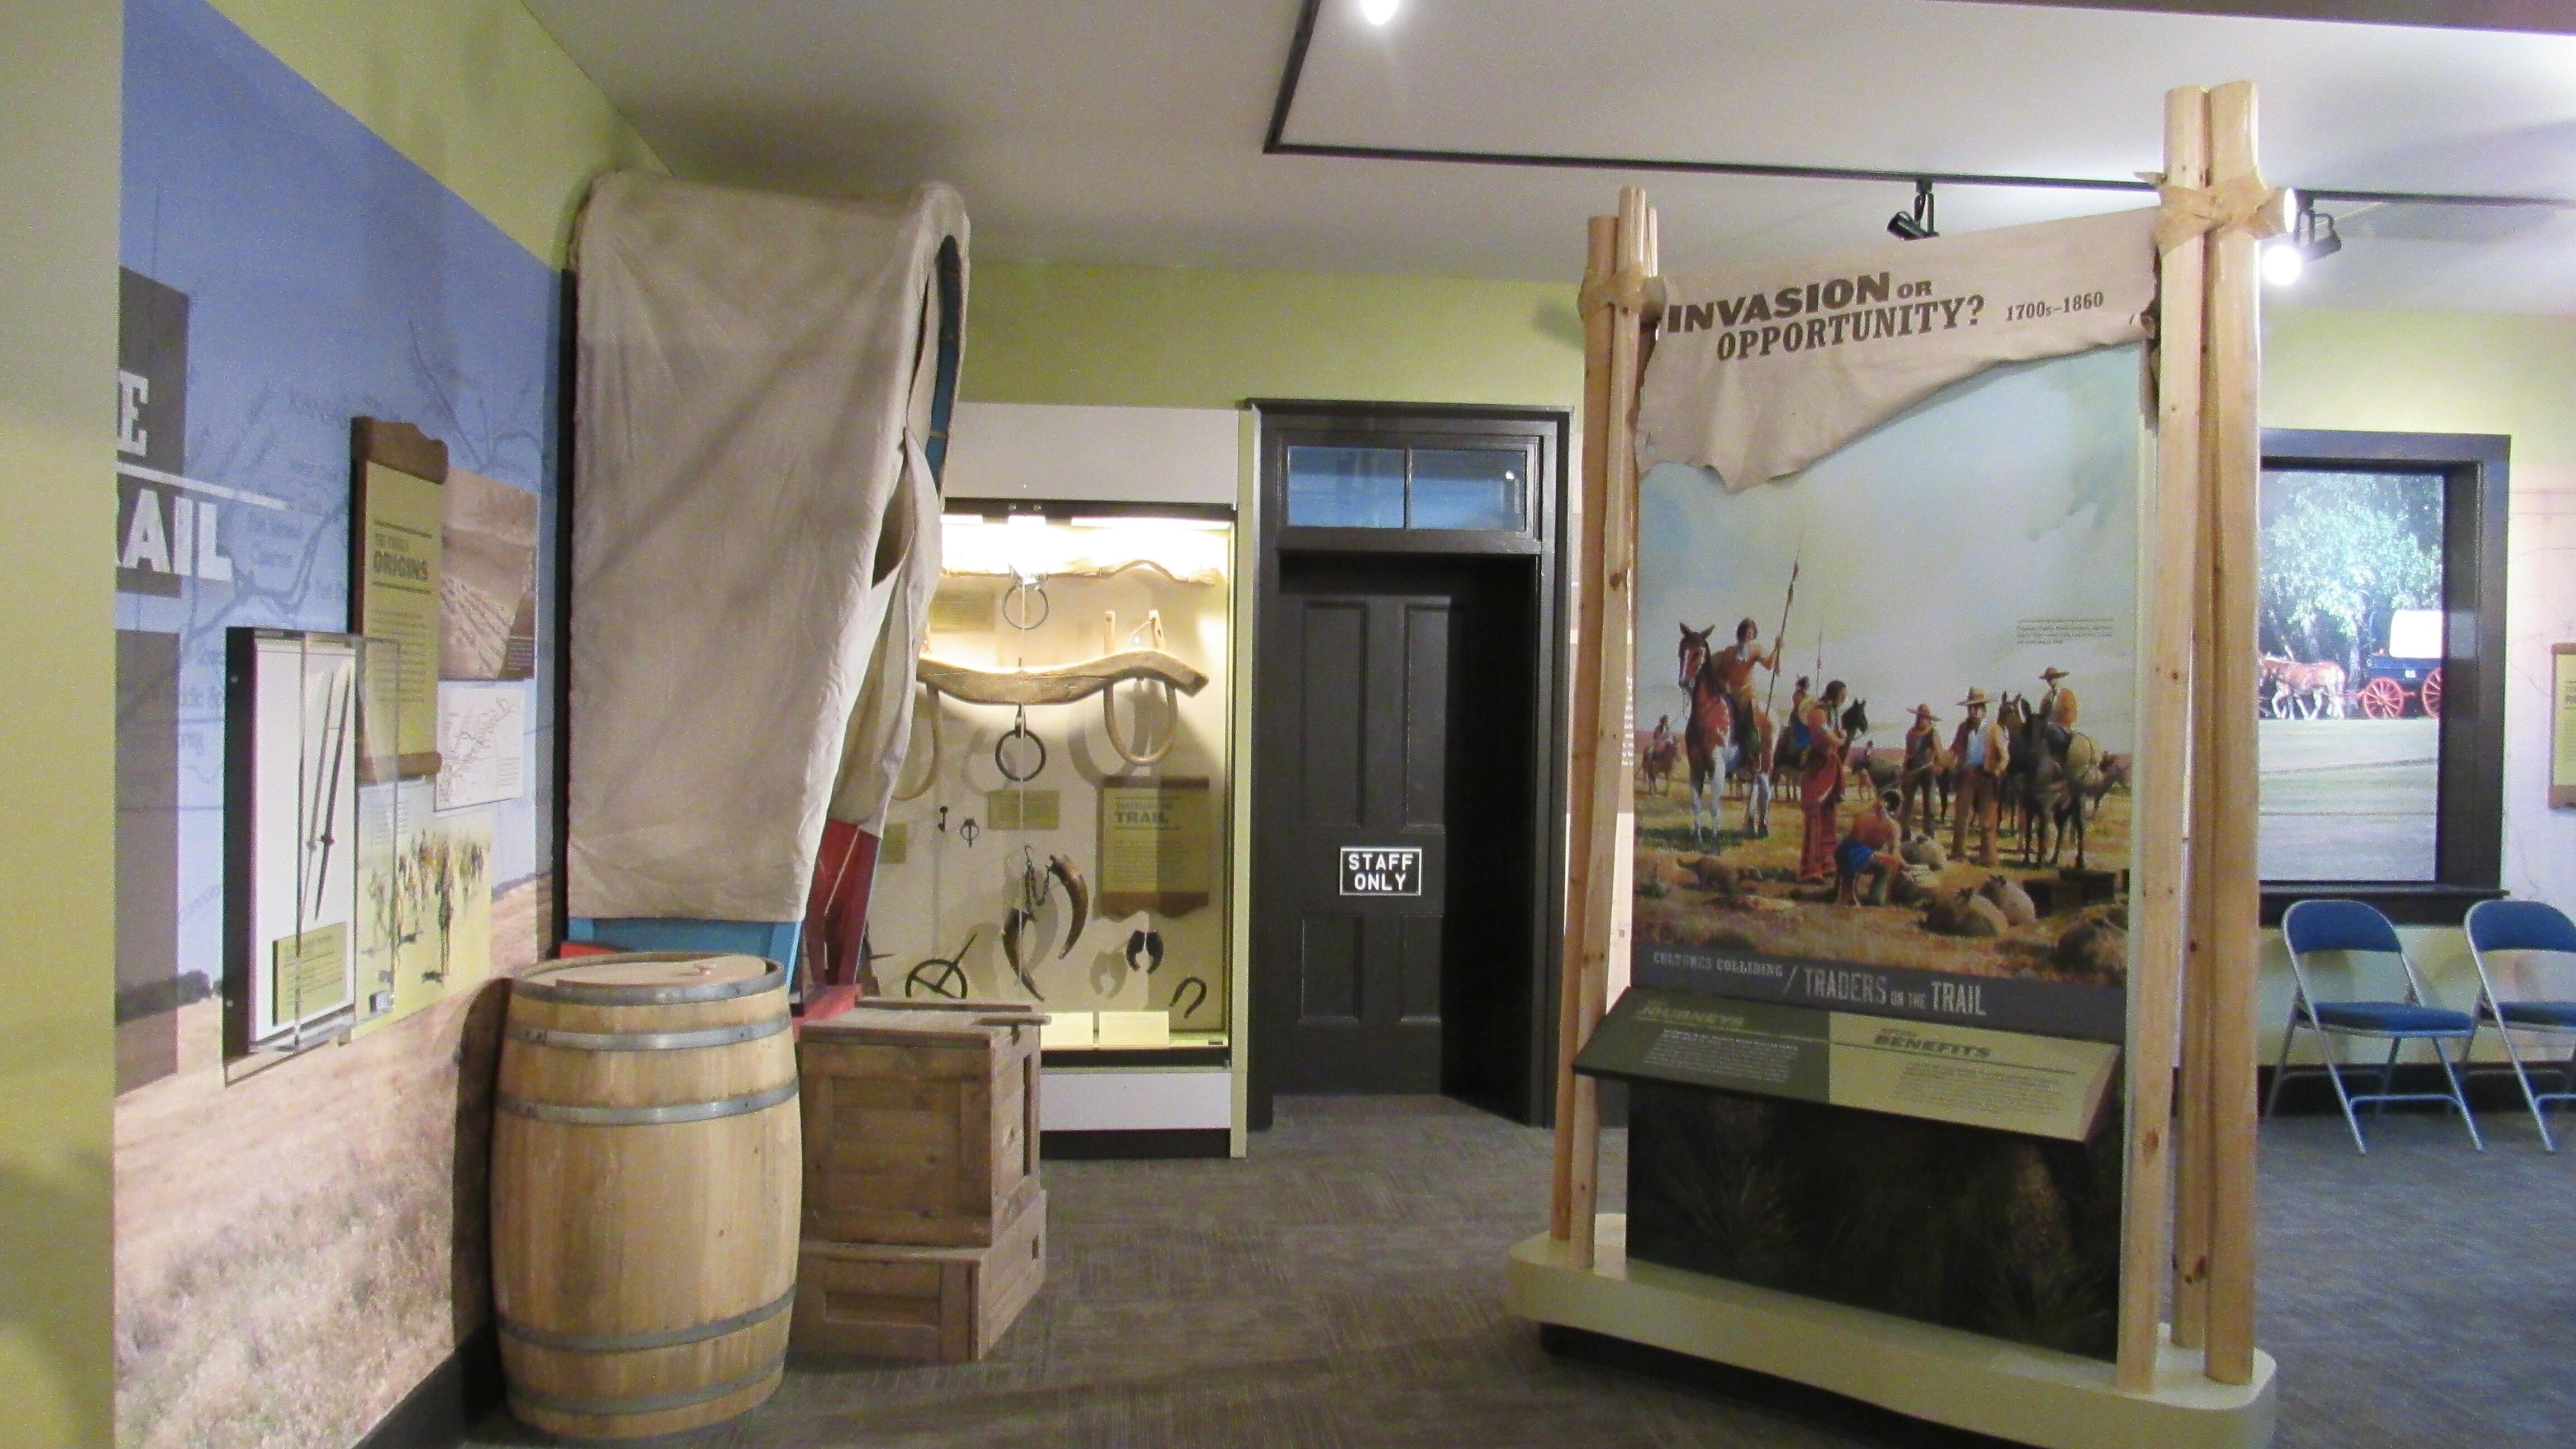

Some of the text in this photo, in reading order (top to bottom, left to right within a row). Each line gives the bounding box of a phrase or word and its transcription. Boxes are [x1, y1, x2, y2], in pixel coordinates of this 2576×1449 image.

[1666, 271, 1933, 334] INVASION OR
[1716, 294, 1985, 362] OPPORTUNITY?
[1348, 853, 1414, 871] STAFF
[1354, 872, 1407, 891] ONLY
[1716, 957, 1784, 977] COLLIDING
[1803, 967, 1887, 1005] TRADERS
[1890, 989, 1904, 1006] ON
[1907, 992, 1926, 1010] THE
[1930, 980, 1986, 1016] TRAIL
[1874, 1034, 1991, 1058] BENEFITS
